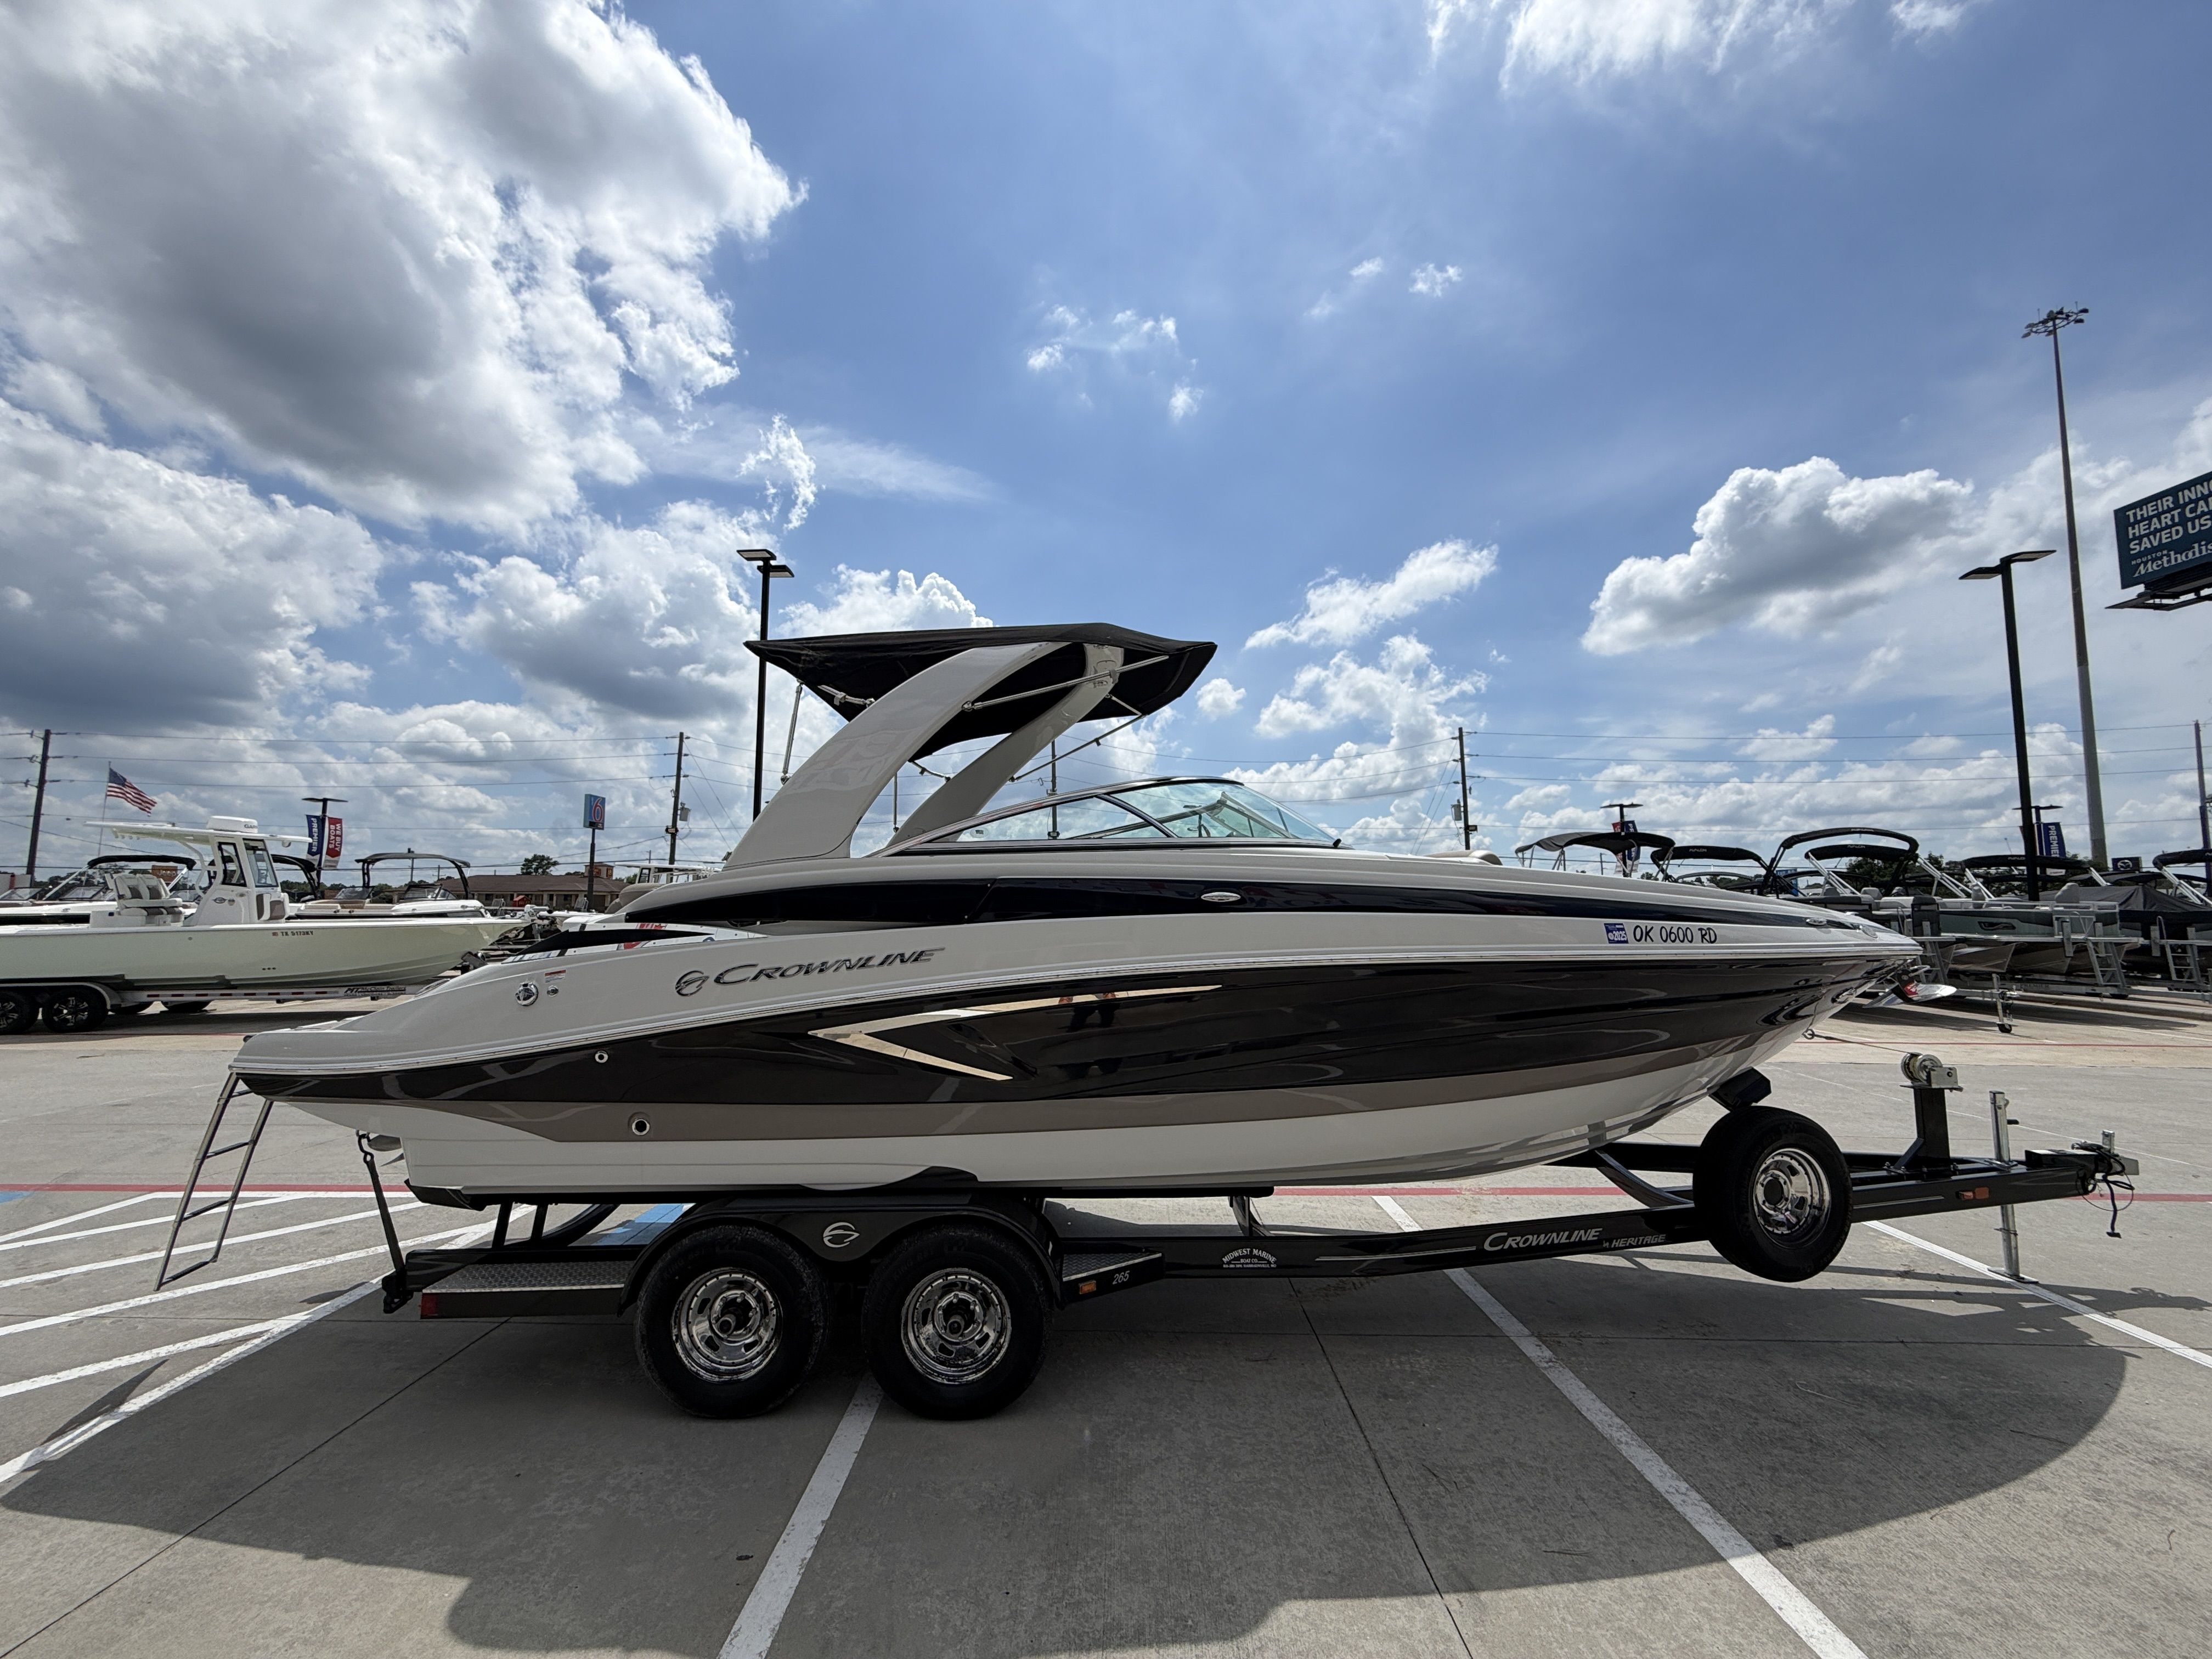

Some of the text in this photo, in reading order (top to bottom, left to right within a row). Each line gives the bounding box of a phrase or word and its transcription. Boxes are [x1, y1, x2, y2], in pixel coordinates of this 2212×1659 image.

[2126, 496, 2174, 523] THEIR
[2128, 509, 2182, 539] HEART
[2129, 515, 2212, 554] SAVED US
[2131, 549, 2168, 565] HOUSTON
[592, 797, 603, 822] 6
[336, 823, 341, 836] WE
[1613, 930, 1627, 941] 2025
[1633, 925, 1717, 944] OK 0600 RD
[714, 947, 945, 985] CROWNLINE
[1483, 1228, 1602, 1251] CROWNLINE
[1611, 1234, 1666, 1248] HERITAGE
[1222, 1248, 1277, 1264] MIDWEST MARINE
[1113, 1270, 1130, 1285] 265
